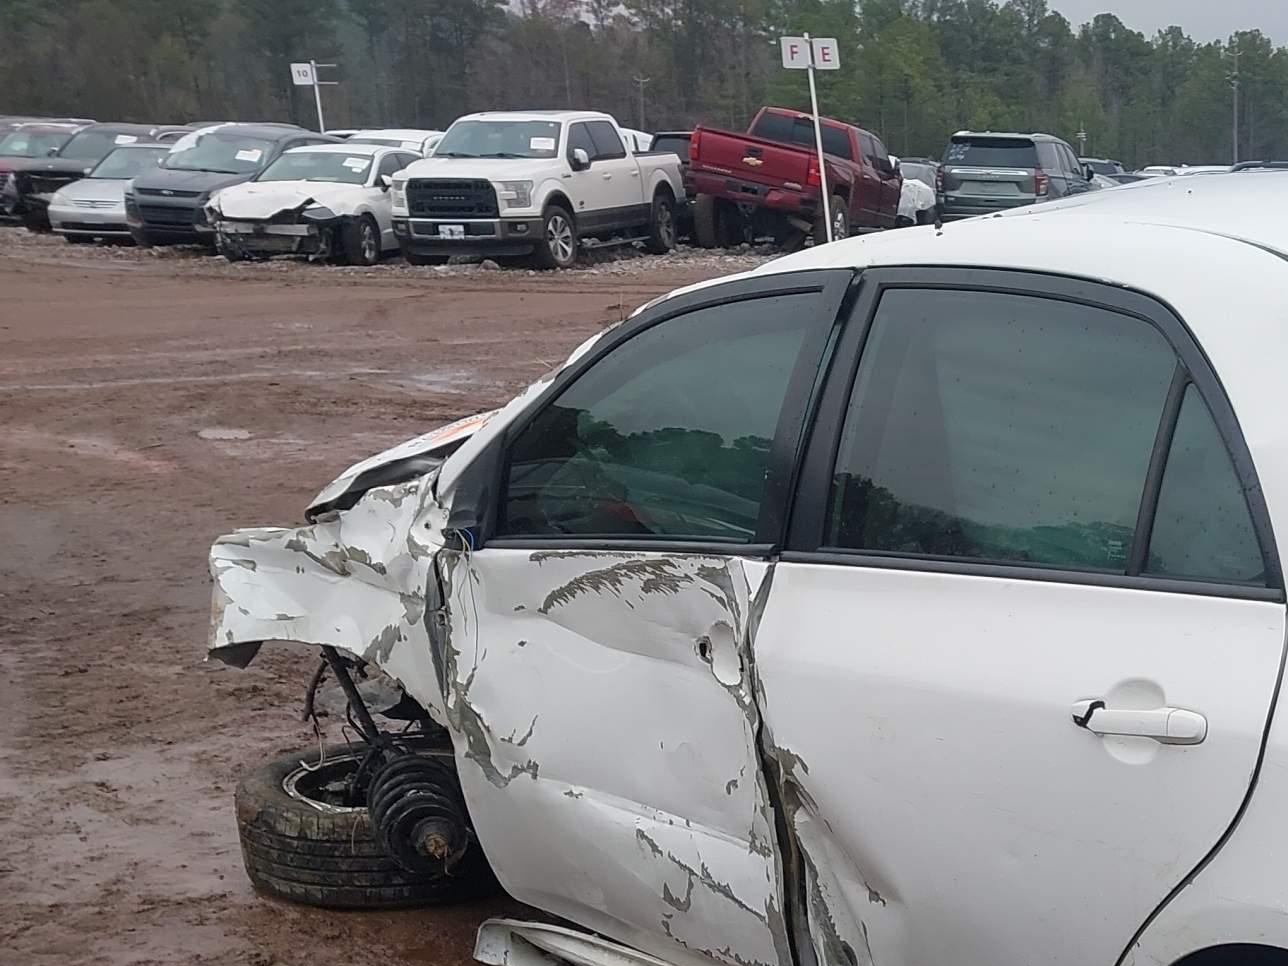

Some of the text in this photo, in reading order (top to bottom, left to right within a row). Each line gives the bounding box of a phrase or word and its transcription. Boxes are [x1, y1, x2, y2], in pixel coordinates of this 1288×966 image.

[790, 44, 799, 61] F
[821, 46, 832, 62] E
[296, 70, 308, 78] 10
